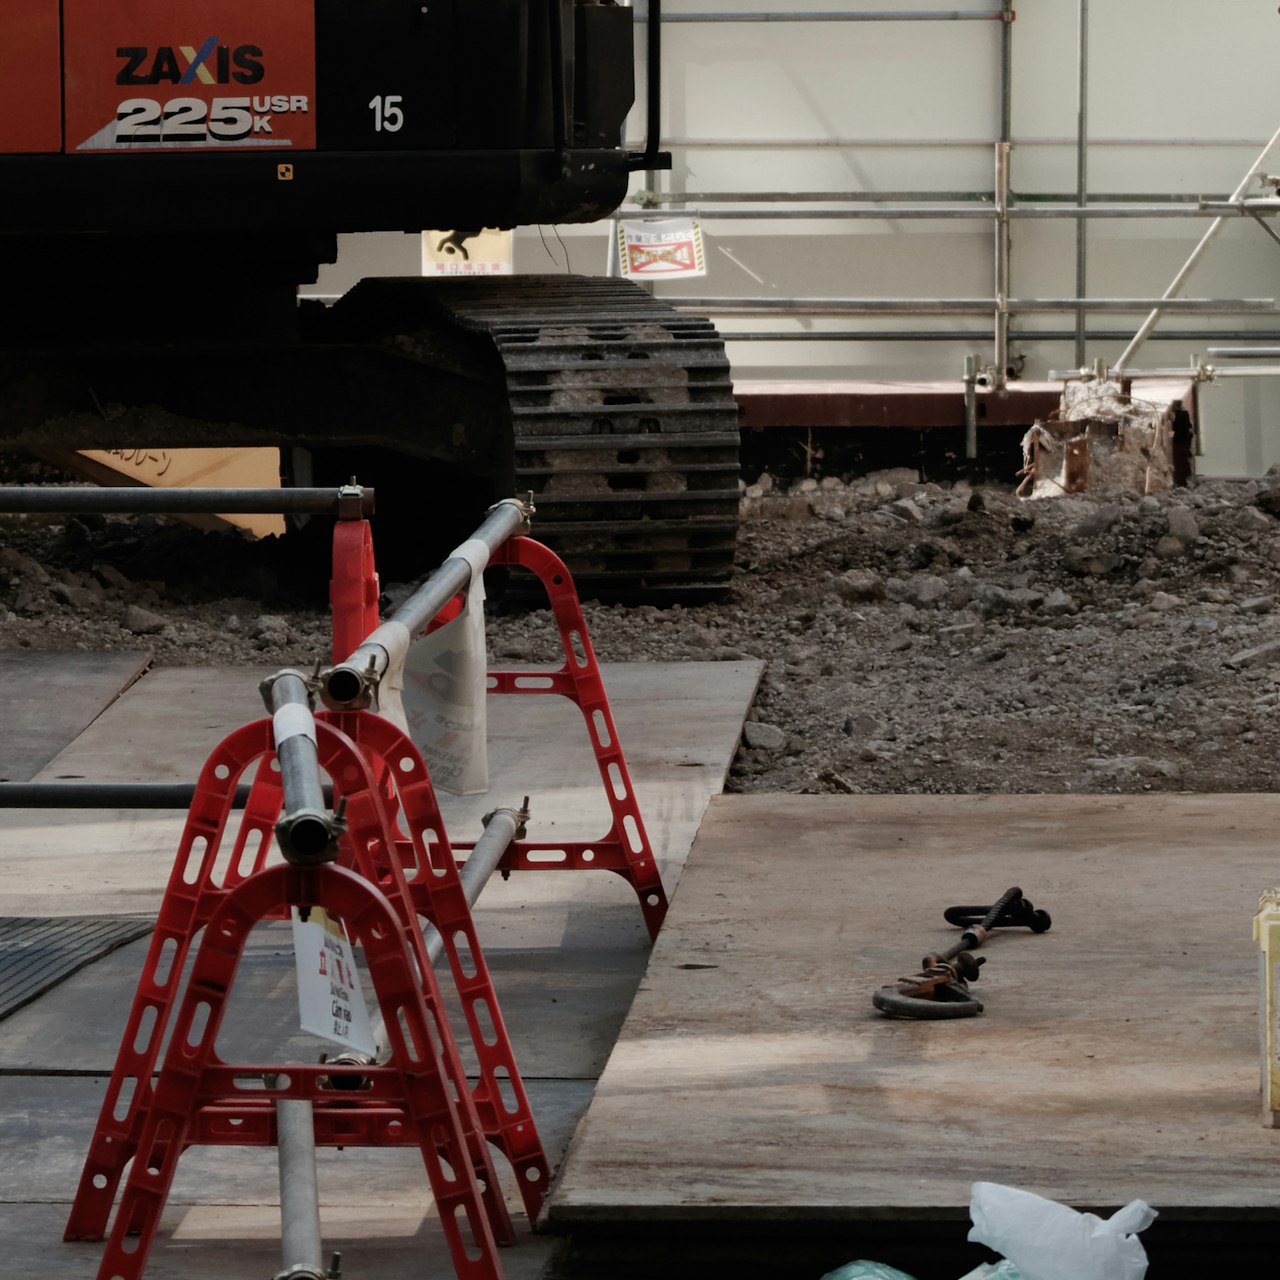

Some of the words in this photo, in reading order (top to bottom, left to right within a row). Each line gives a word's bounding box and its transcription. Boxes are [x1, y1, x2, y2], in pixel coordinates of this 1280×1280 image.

[115, 36, 265, 86] ZAXIS
[115, 97, 252, 143] 225
[252, 95, 308, 112] USR
[253, 115, 273, 133] K
[368, 94, 404, 133] 15
